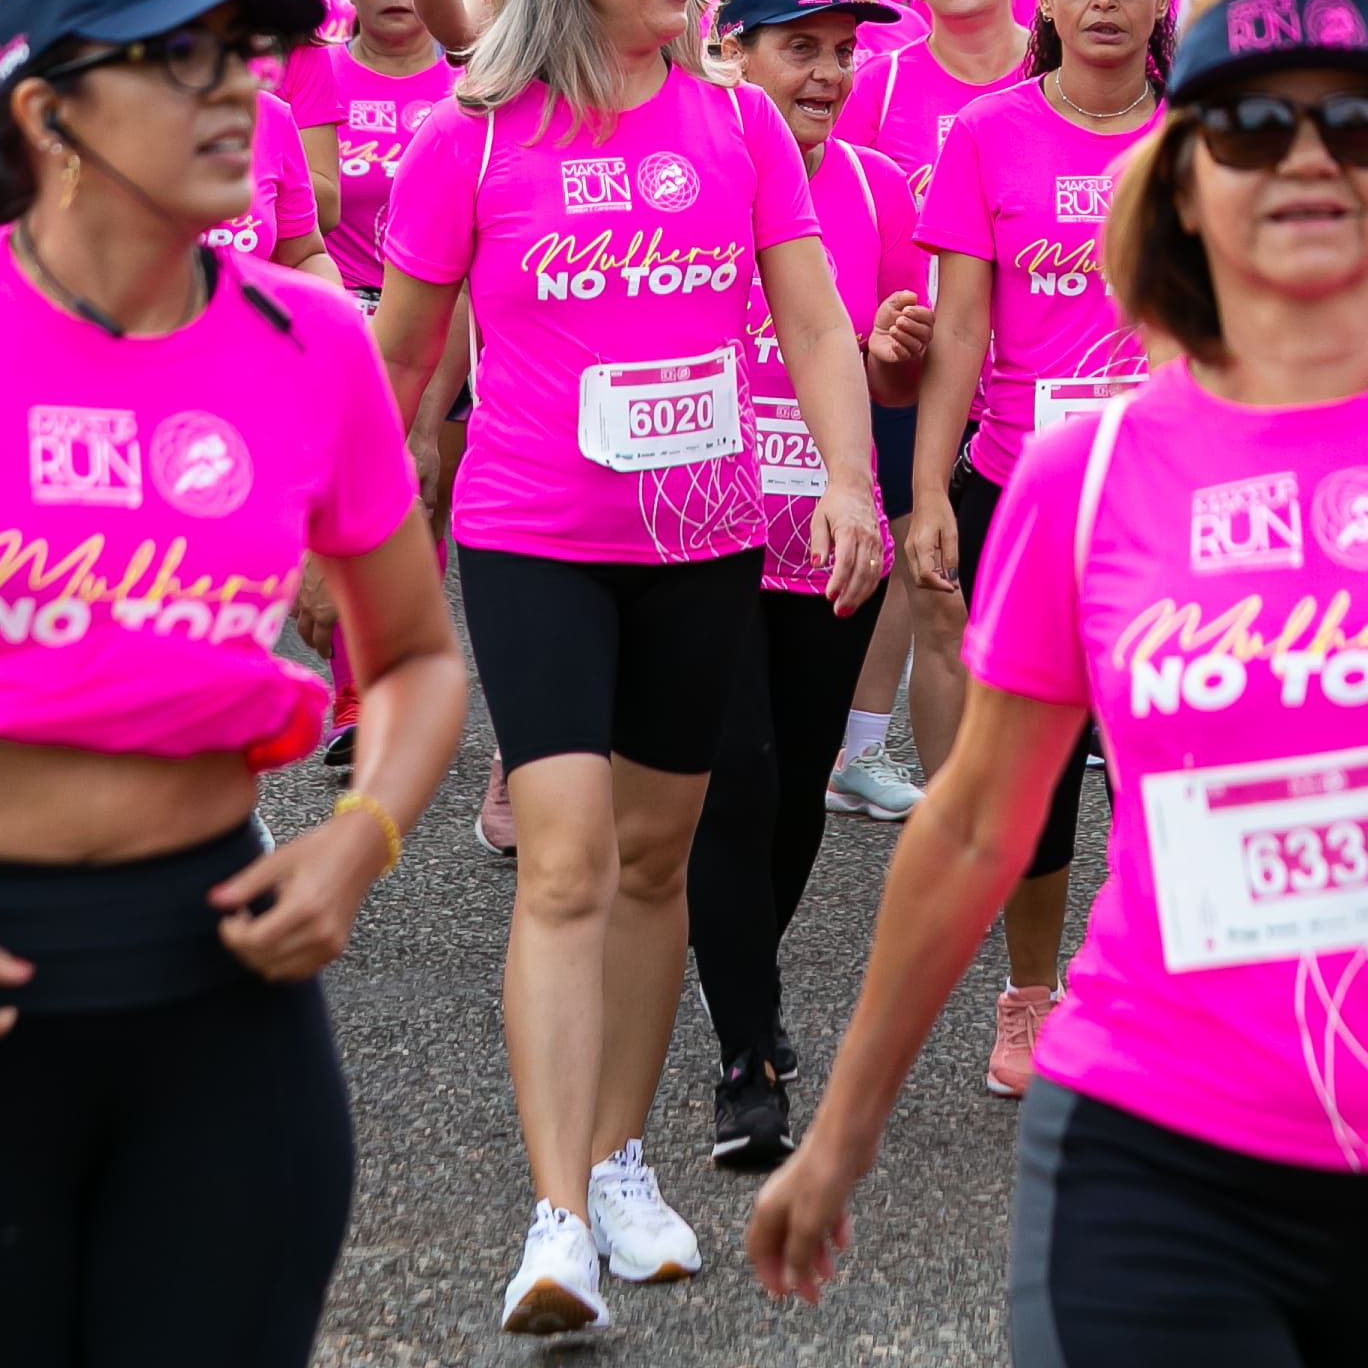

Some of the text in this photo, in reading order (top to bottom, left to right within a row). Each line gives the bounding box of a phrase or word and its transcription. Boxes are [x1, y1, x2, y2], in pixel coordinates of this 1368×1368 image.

[350, 110, 397, 128] RUN
[562, 161, 626, 178] MAKEUP
[1056, 180, 1113, 192] MAKEUP
[564, 174, 632, 206] RUN
[1056, 191, 1114, 215] RUN
[522, 227, 745, 274] Mulheres
[537, 263, 738, 301] NO TOPO
[1030, 271, 1088, 296] NO
[630, 394, 714, 436] 6020
[32, 435, 141, 488] RUN
[1192, 500, 1302, 557] RUN
[1131, 653, 1248, 719] NO
